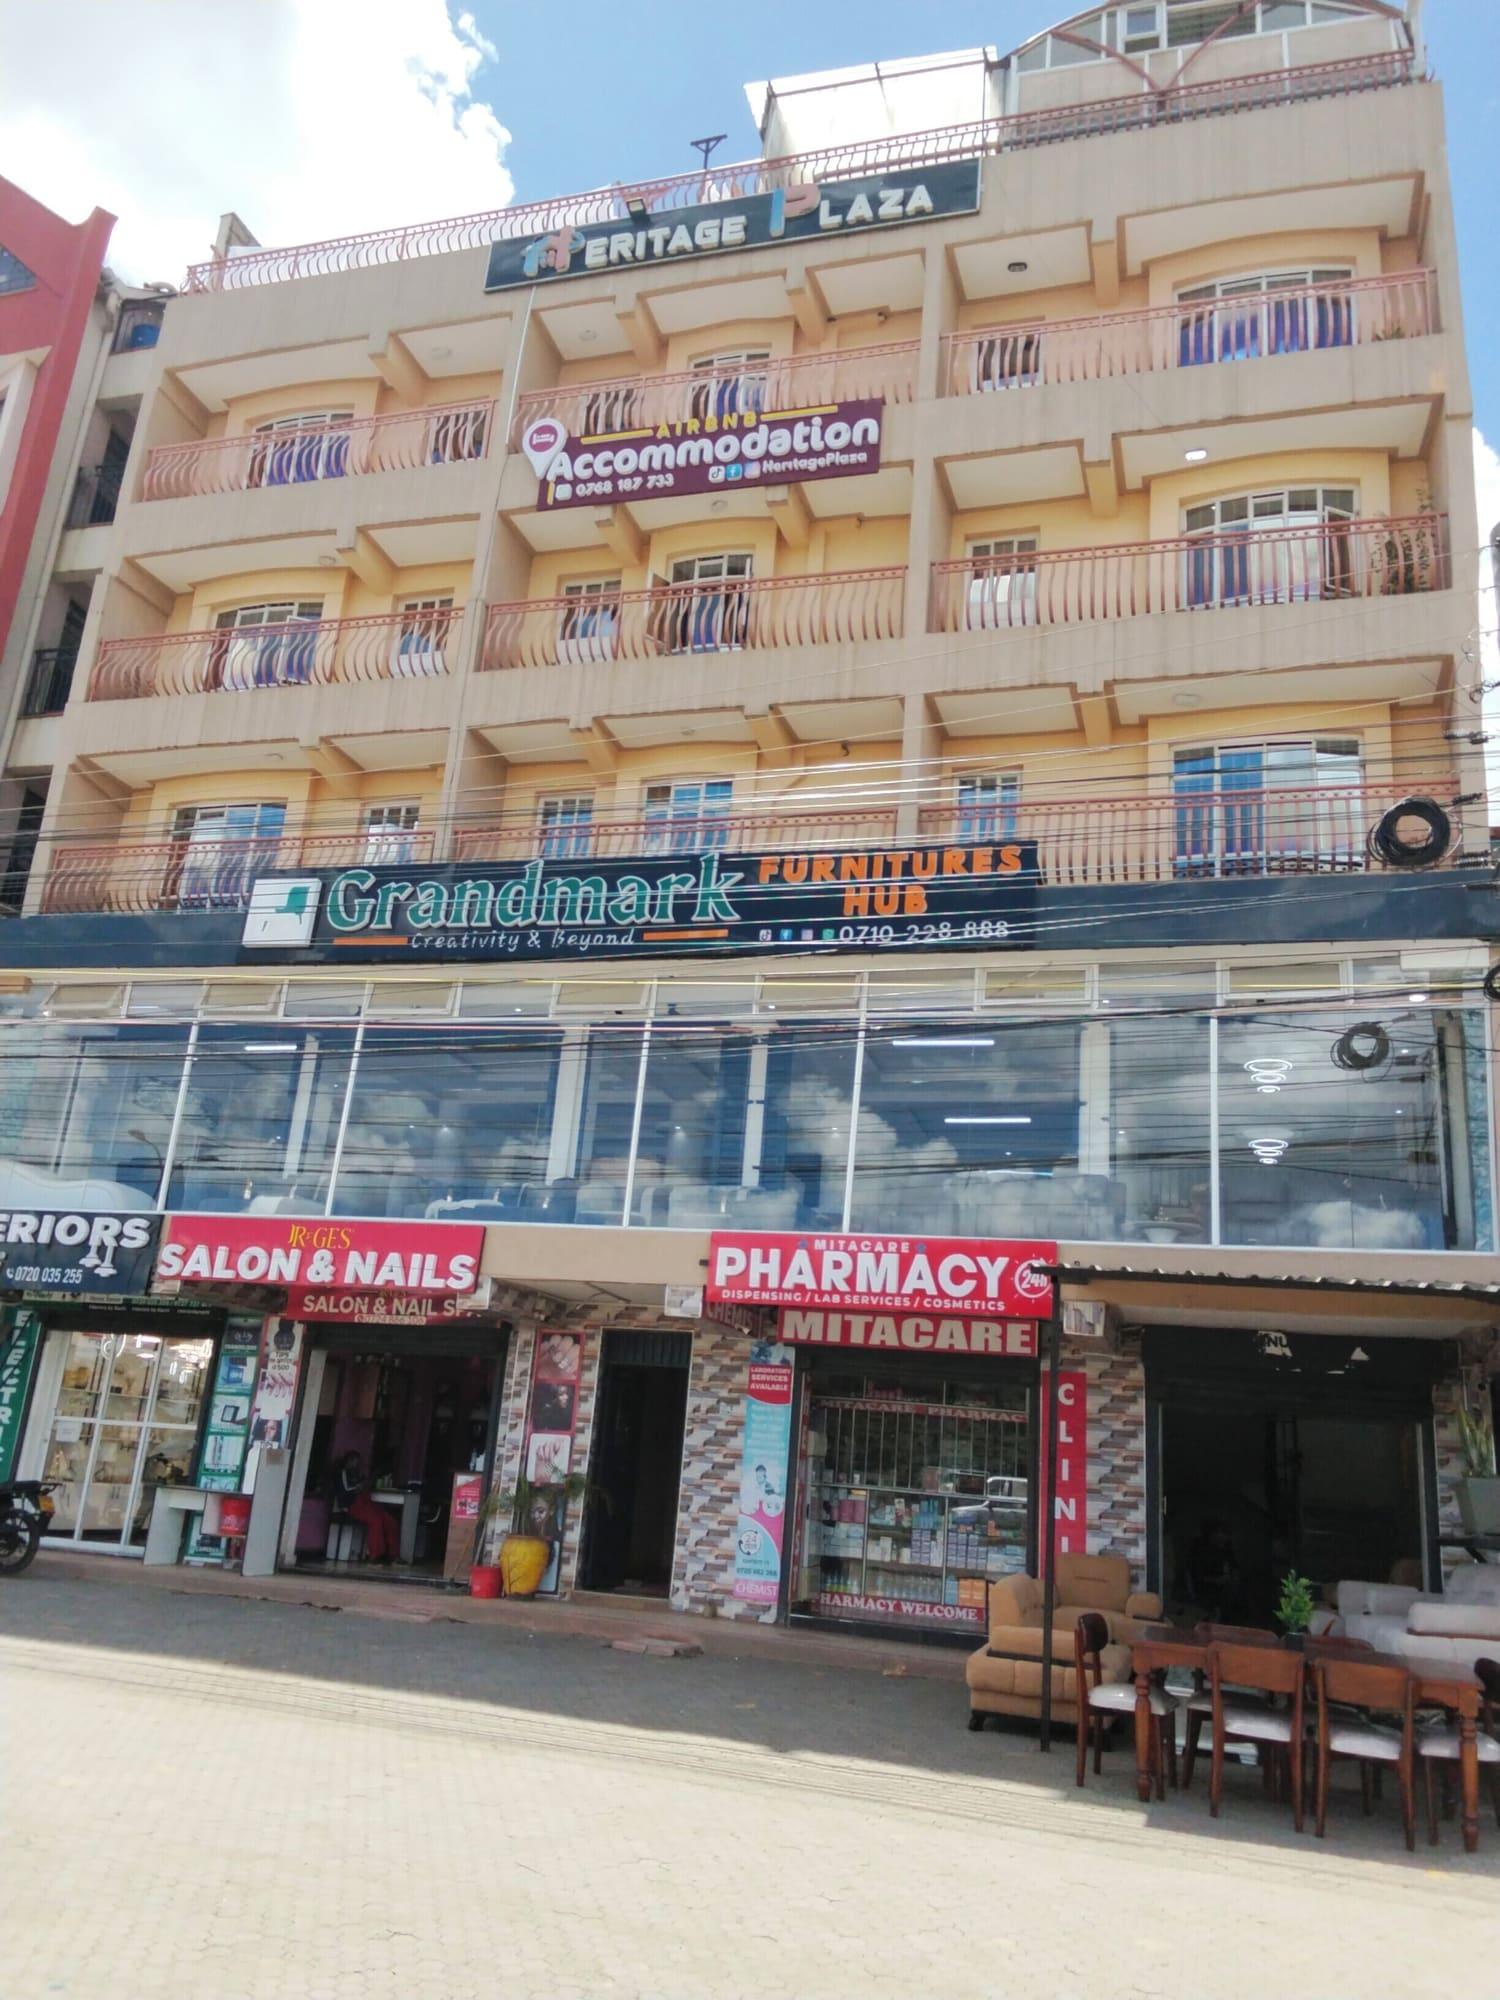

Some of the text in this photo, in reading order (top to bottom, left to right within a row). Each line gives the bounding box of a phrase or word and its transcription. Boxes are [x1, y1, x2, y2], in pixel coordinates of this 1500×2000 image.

[769, 183, 934, 238] PLAZA
[656, 410, 757, 440] AIRBNB
[546, 416, 880, 482] Accommodation
[647, 474, 675, 488] 733
[758, 845, 1023, 885] FURNITURES
[327, 852, 744, 932] Grandmark
[843, 885, 928, 917] HUB
[412, 928, 636, 951] Creativity & Beyond
[839, 920, 1010, 943] 0710 228 888
[814, 1239, 910, 1253] MITACARE
[14, 1266, 83, 1284] 0720 035 255
[157, 1243, 476, 1290] SALON & NAILS
[715, 1247, 1009, 1298] PHARMACY
[303, 1295, 369, 1314] SALON
[373, 1297, 387, 1316] &
[392, 1299, 437, 1317] NAIL
[721, 1289, 802, 1303] DISPENSING
[814, 1292, 841, 1305] LAB
[844, 1293, 911, 1307] SERVICES
[923, 1298, 1006, 1312] COSMETICS
[782, 1310, 1032, 1354] MITACARE
[901, 1601, 978, 1621] WELCOME
